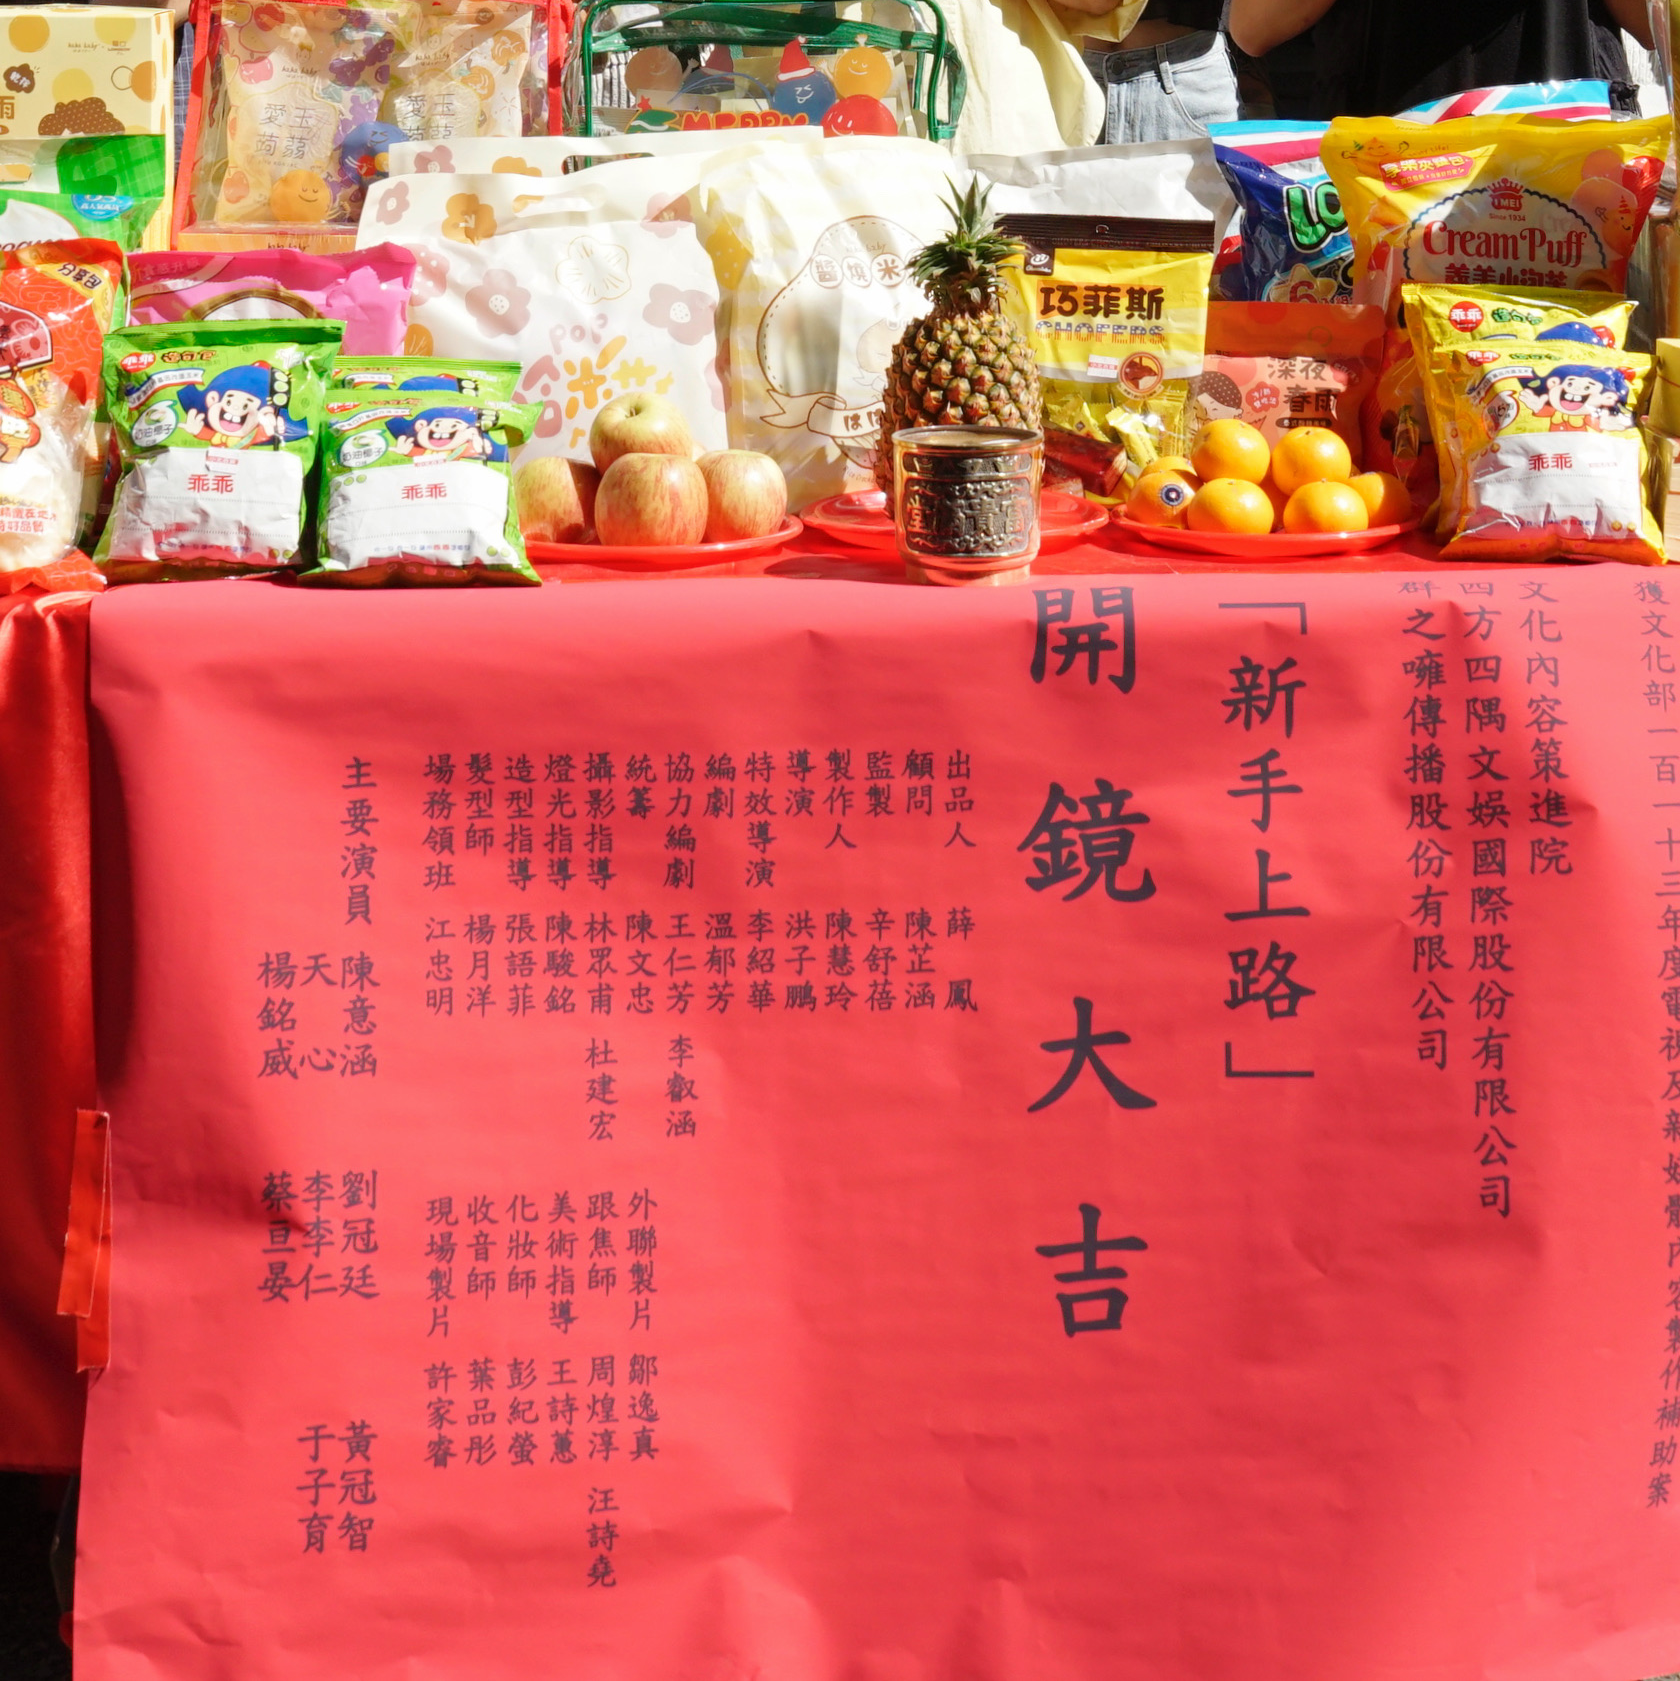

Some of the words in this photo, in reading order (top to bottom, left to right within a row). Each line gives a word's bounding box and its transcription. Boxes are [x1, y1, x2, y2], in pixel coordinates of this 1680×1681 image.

[255, 133, 306, 159] 蒟蒻
[260, 104, 316, 129] 愛玉
[1423, 220, 1519, 261] Cream
[1520, 227, 1587, 267] Puff
[1489, 213, 1507, 221] Since
[1508, 214, 1526, 222] 1934
[1501, 198, 1520, 208] MEI
[57, 262, 103, 290] 分享包
[1040, 285, 1165, 320] 巧菲斯
[1451, 308, 1482, 322] 乖乖
[123, 352, 155, 365] 乖乖
[1036, 321, 1165, 344] CHOFERS
[1268, 357, 1327, 381] 深夜
[135, 423, 173, 440] 奶油椰子
[1283, 385, 1342, 413] 春雨
[187, 473, 234, 494] 乖乖
[342, 446, 384, 462] 奶油椰子
[401, 483, 447, 501] 乖乖
[1528, 452, 1573, 471] 乖乖
[1520, 580, 1574, 876] 文化內容策進院
[423, 754, 456, 889] 場務領班
[465, 753, 494, 854] 髮型師
[504, 754, 536, 891] 造型指導
[544, 754, 576, 890] 燈光指導
[583, 752, 616, 890] 攝影指導
[625, 754, 657, 819] 統籌
[664, 752, 696, 889] 協力編劇
[704, 753, 736, 818] 編劇
[744, 752, 776, 887] 特效導演
[786, 749, 816, 816] 導演
[824, 749, 856, 848] 製作人
[865, 751, 894, 817] 監製
[902, 749, 934, 816] 顧問
[945, 750, 976, 847] 出品人
[341, 757, 378, 924] 主要演員
[1219, 603, 1316, 1078] 「新手上路」
[426, 918, 455, 1015] 江忠明
[464, 914, 496, 1016] 楊月洋
[505, 914, 537, 1015] 張語菲
[544, 912, 577, 1013] 陳駿銘
[626, 910, 657, 1014] 陳文忠
[664, 914, 696, 1014] 王仁芳
[705, 913, 736, 1014] 溫郁芳
[746, 910, 775, 1012] 李紹華
[785, 910, 817, 1012] 洪子鵬
[825, 908, 857, 1011] 陳慧玲
[864, 908, 897, 1011] 辛舒蓓
[1017, 587, 1157, 1338] 開鏡大吉
[258, 952, 301, 1079] 楊銘威
[340, 952, 380, 1076] 陳意涵
[586, 1038, 617, 1140] 杜建宏
[299, 1170, 338, 1301] 李李仁
[340, 1170, 379, 1299] 劉冠廷
[425, 1197, 459, 1336] 現場製片
[467, 1195, 498, 1300] 收音師
[507, 1195, 539, 1298] 化妝師
[546, 1191, 578, 1334] 美術指導
[586, 1192, 618, 1296] 跟焦師
[627, 1189, 657, 1330] 外聯製片
[424, 1362, 456, 1468] 許家睿
[465, 1357, 496, 1465] 葉品彤
[296, 1425, 335, 1553] 于子育
[338, 1420, 377, 1552] 黃冠智
[587, 1488, 619, 1587] 汪詩堯
